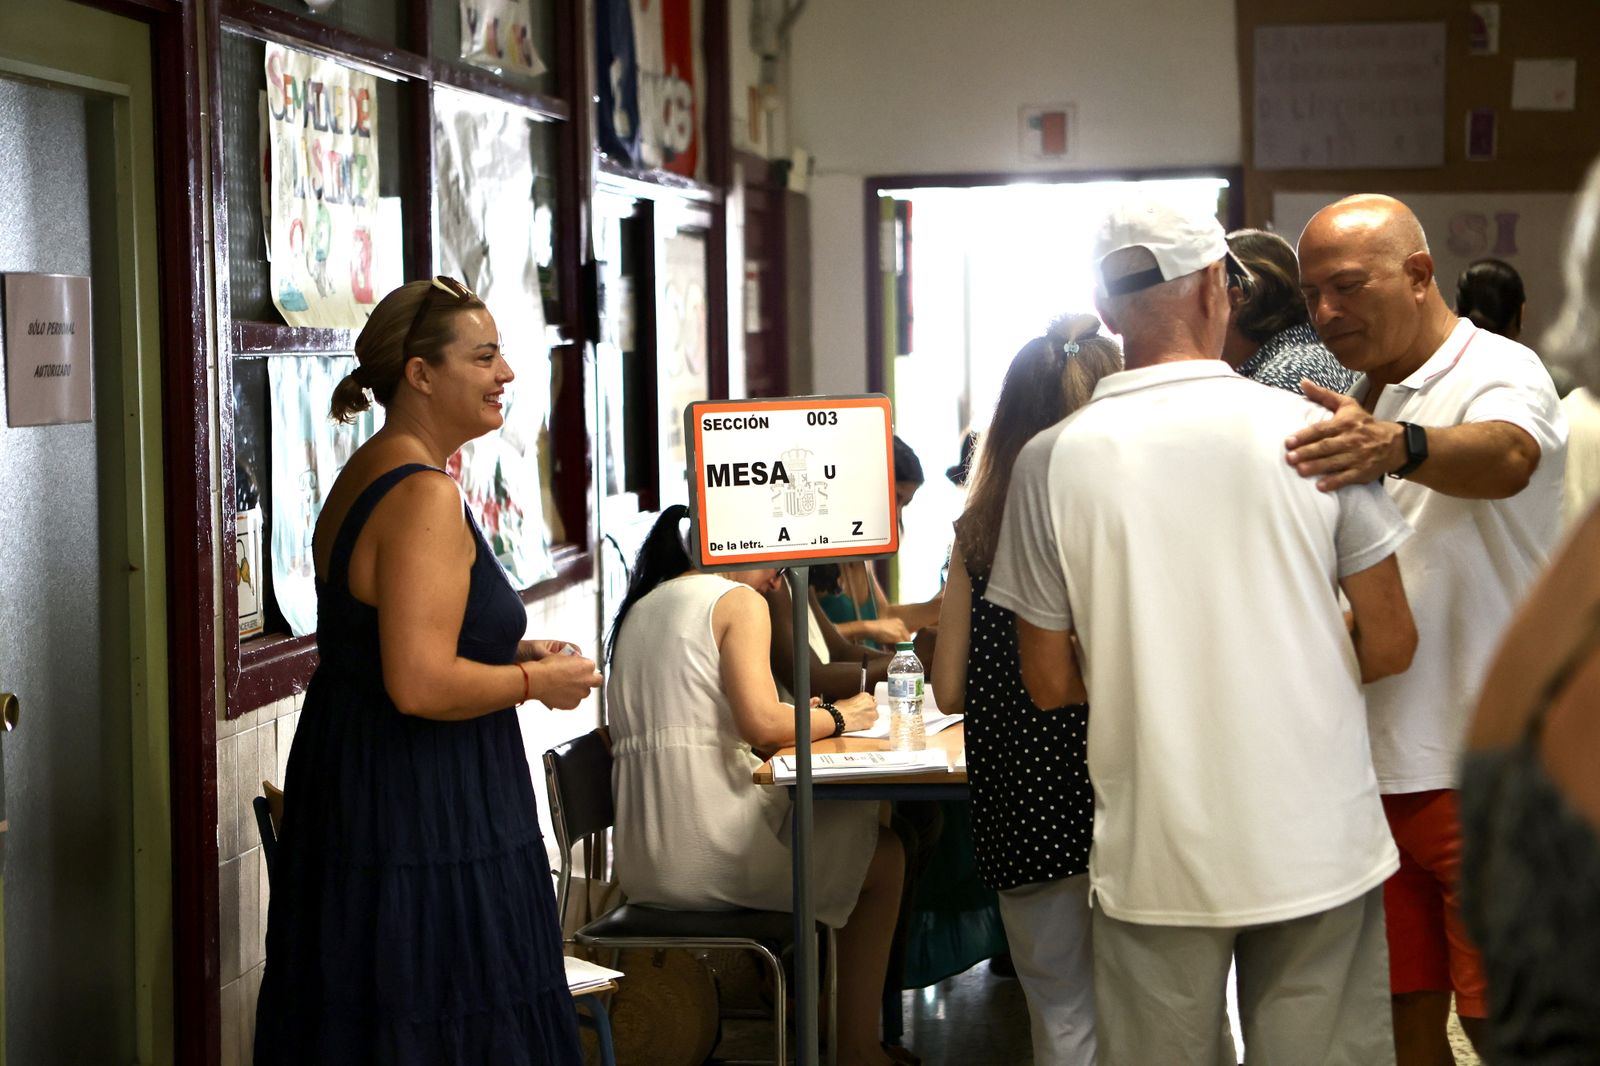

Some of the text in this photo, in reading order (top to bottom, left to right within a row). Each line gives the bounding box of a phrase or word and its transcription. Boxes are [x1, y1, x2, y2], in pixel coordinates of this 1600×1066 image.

[34, 363, 71, 378] AUTORIZADO
[703, 411, 838, 431] SECCIÓN 003
[706, 461, 836, 488] MESA U
[710, 542, 724, 551] De
[727, 540, 737, 550] la
[778, 527, 791, 542] A
[820, 535, 829, 545] la
[852, 521, 864, 536] Z
